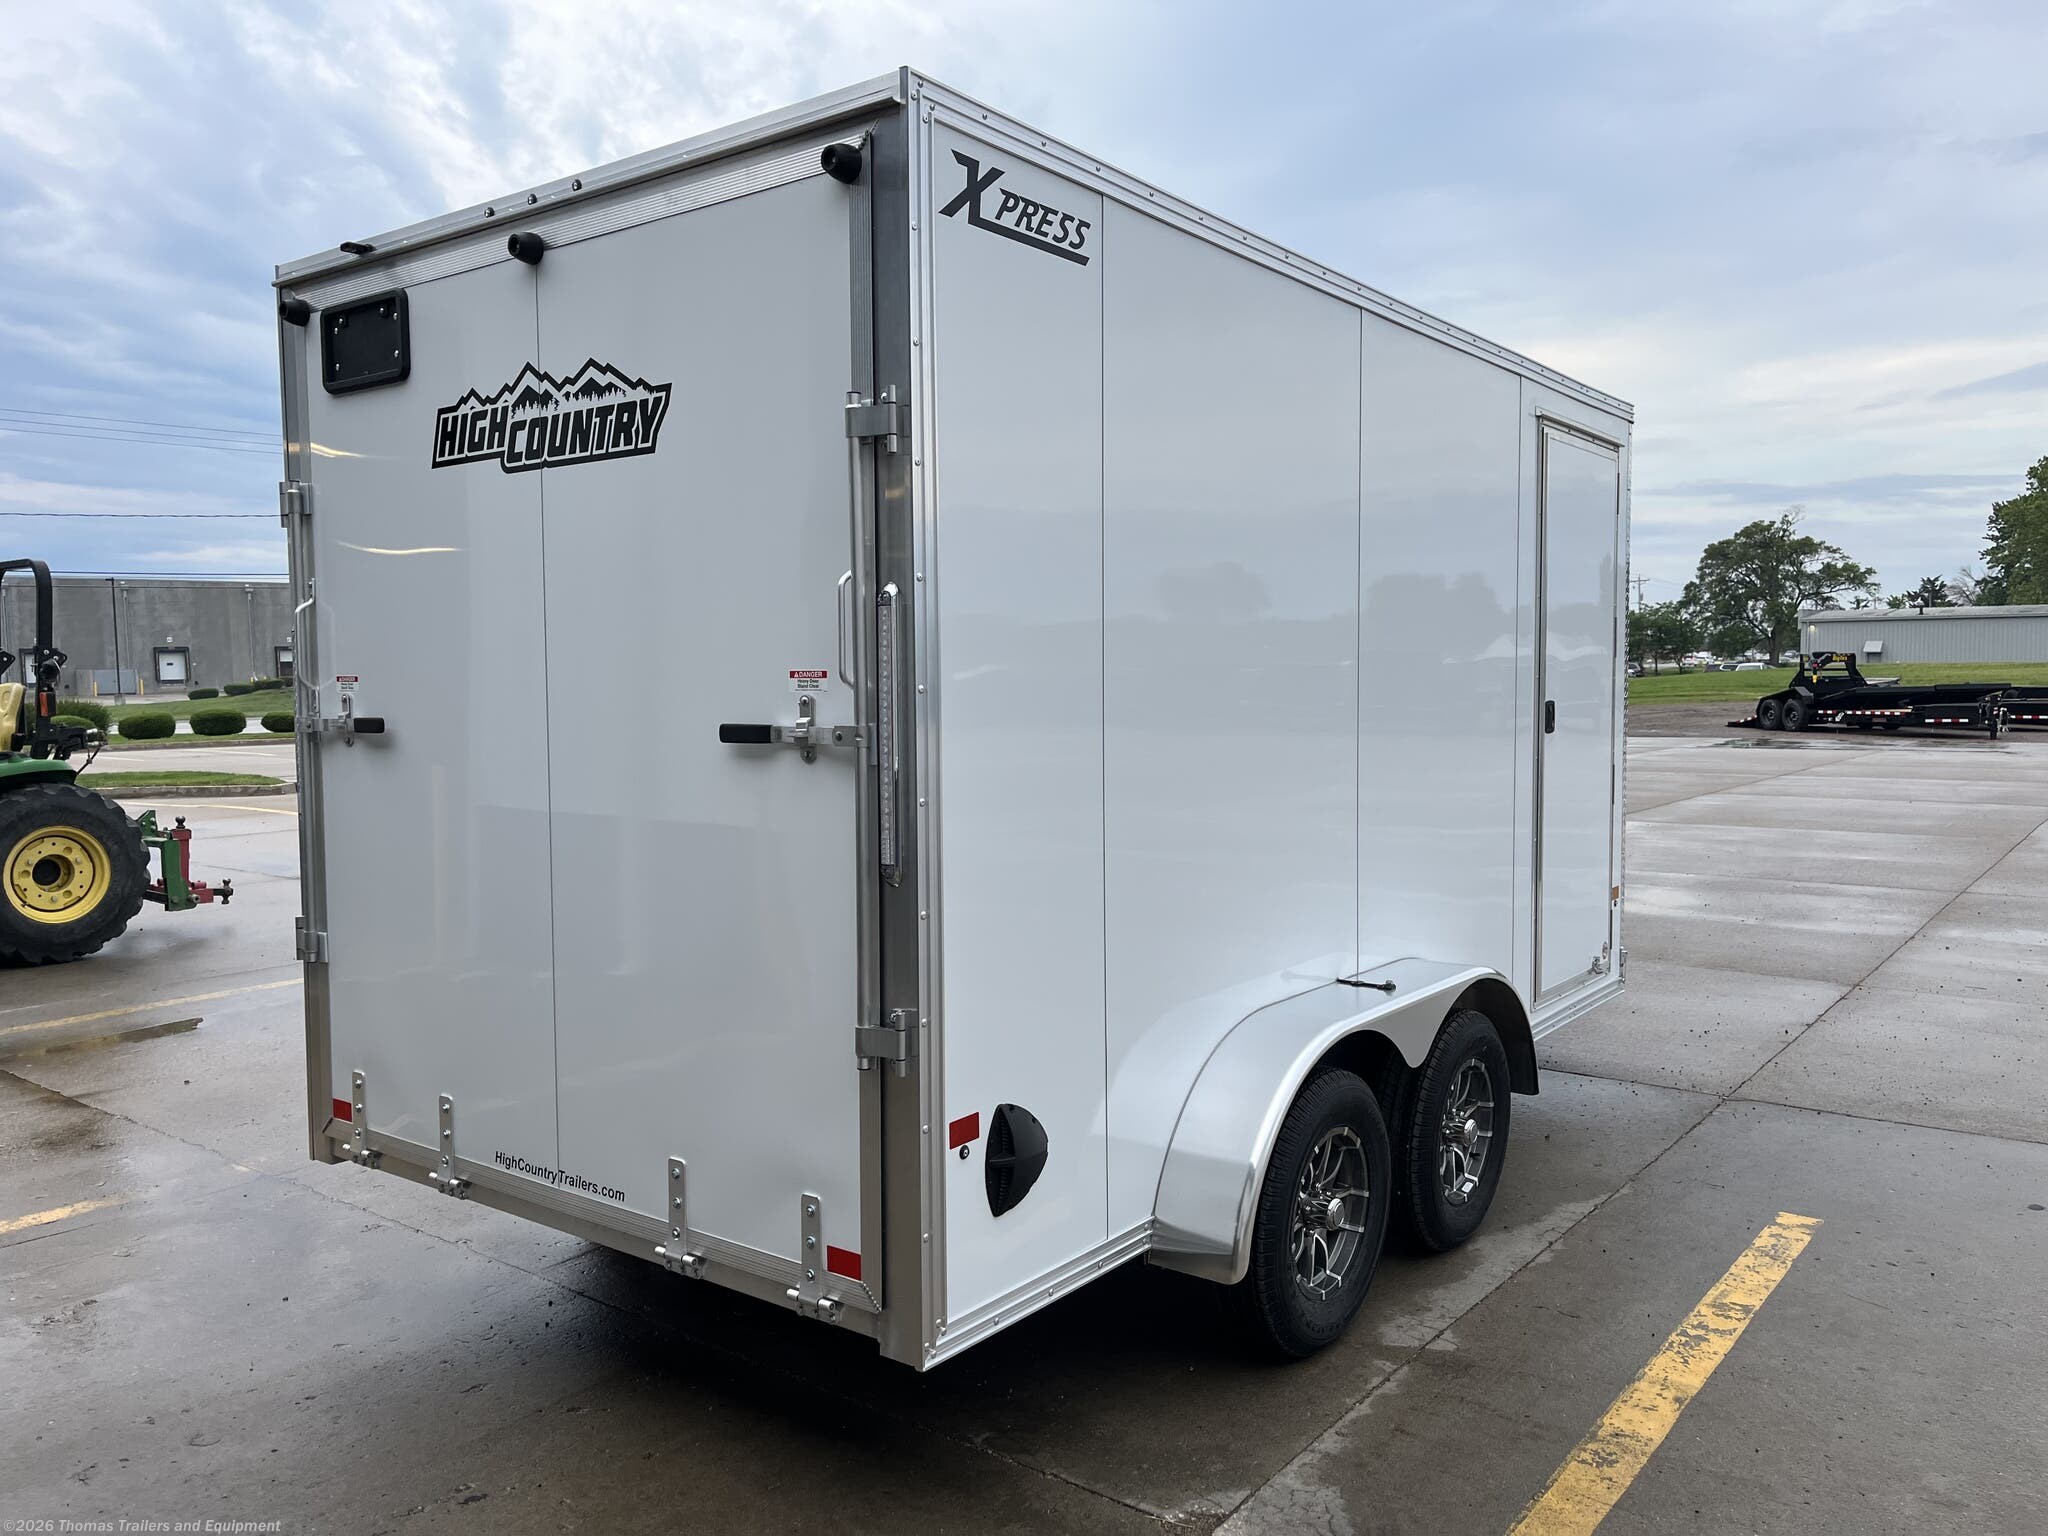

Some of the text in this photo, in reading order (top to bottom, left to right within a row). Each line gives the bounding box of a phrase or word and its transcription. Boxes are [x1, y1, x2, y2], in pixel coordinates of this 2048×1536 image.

[938, 148, 1092, 250] XPRESS
[437, 395, 664, 464] HIGH COUNTRY
[495, 1151, 625, 1202] HighCountryTrailers.com
